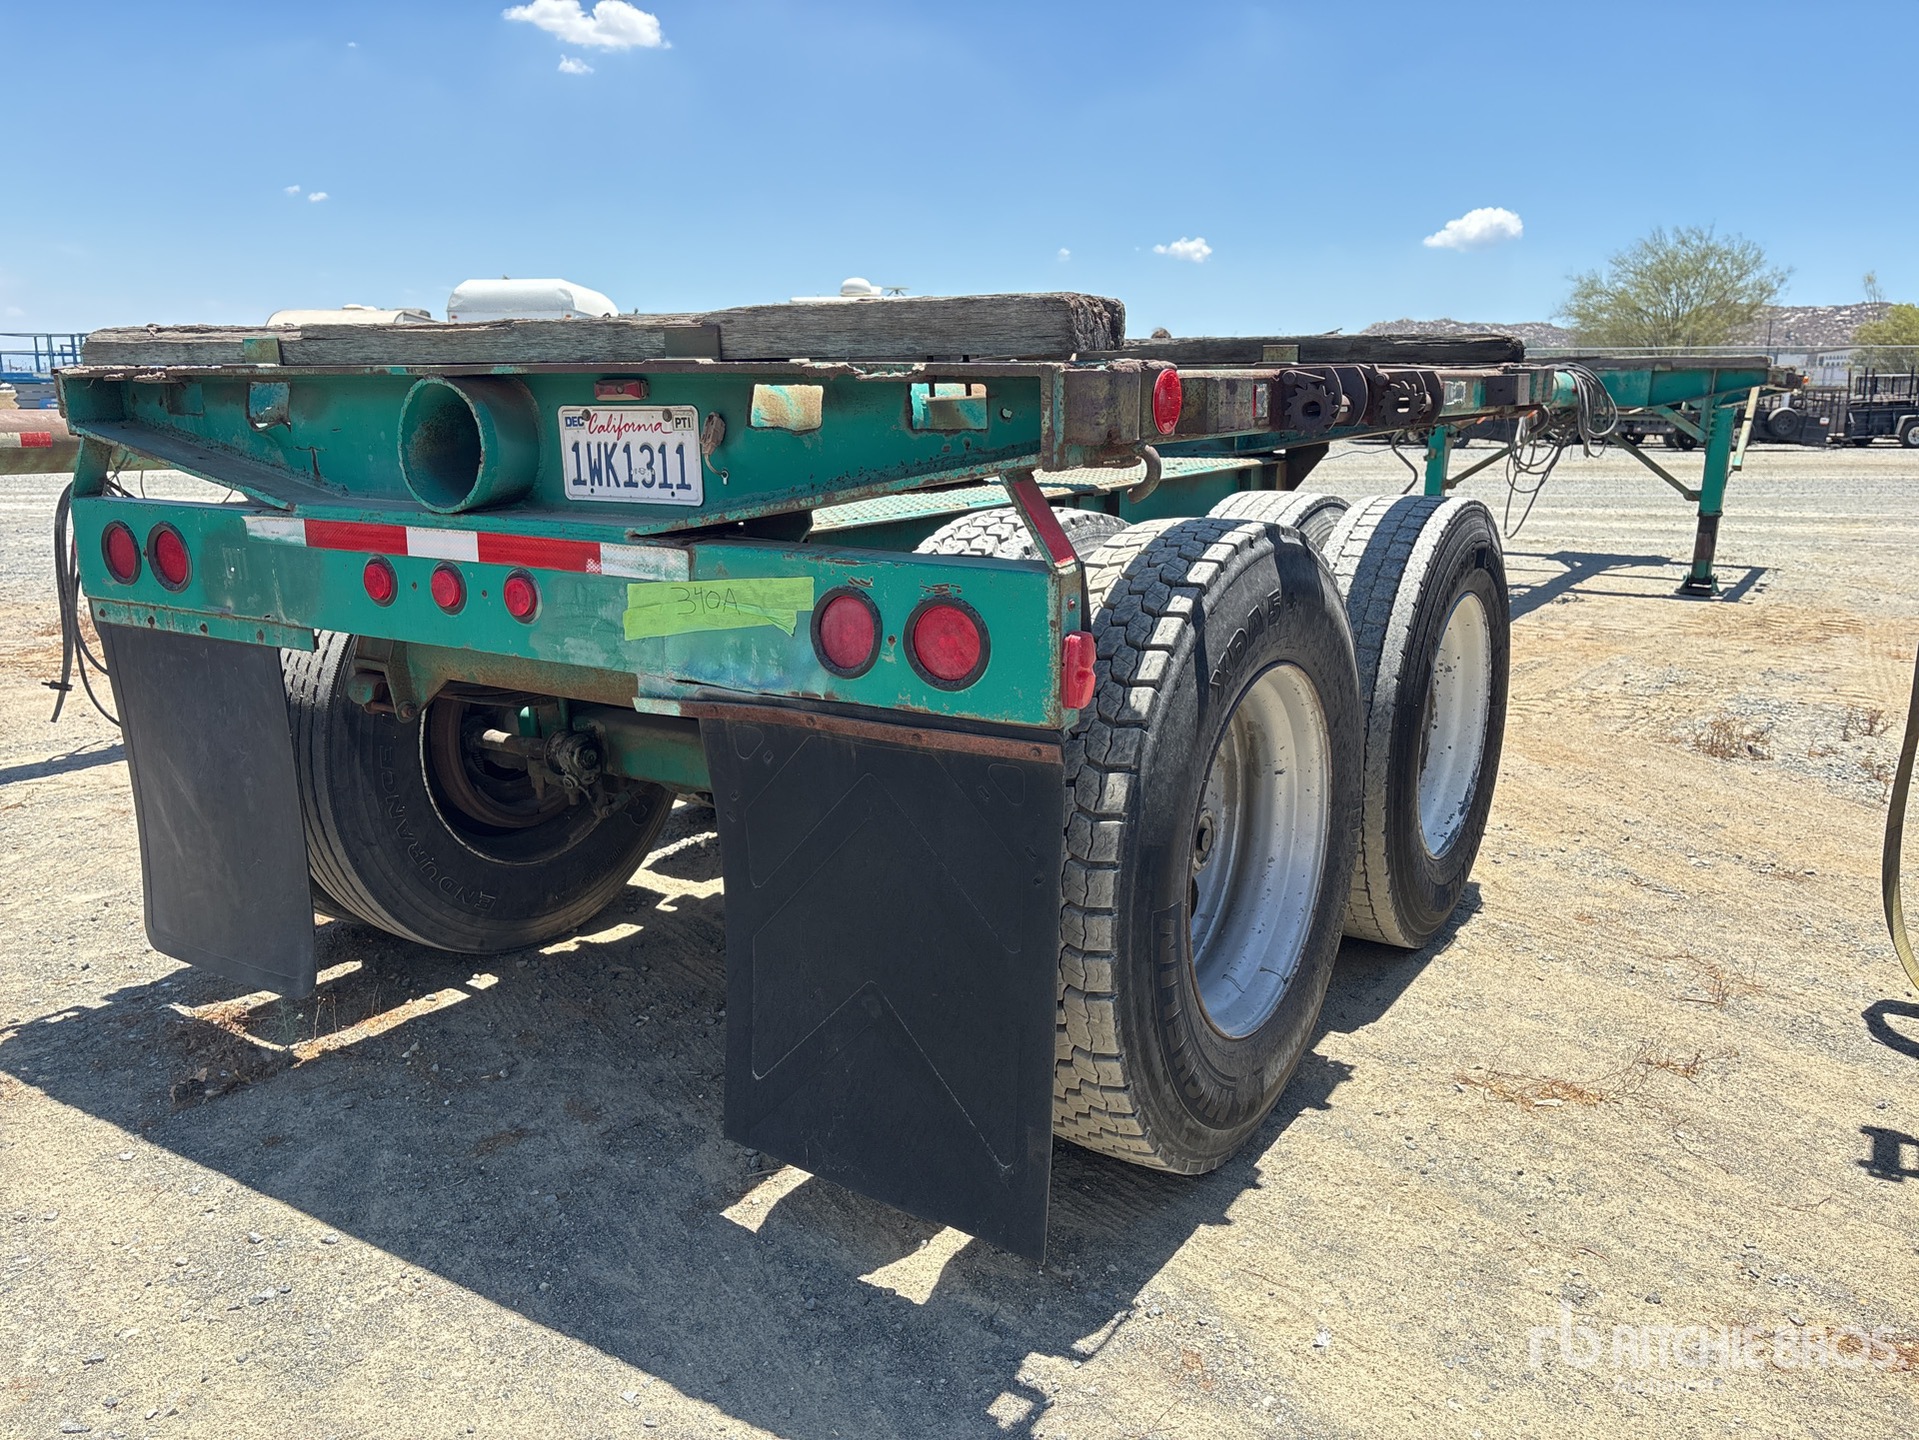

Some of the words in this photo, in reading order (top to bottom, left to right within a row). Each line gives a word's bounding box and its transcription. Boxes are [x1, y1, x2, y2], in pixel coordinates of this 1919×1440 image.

[565, 416, 585, 427] DEC
[588, 413, 673, 441] California
[674, 417, 691, 428] PTI
[571, 441, 692, 490] 1WK1311
[671, 587, 741, 616] 340A
[379, 746, 496, 913] ENDURANCE
